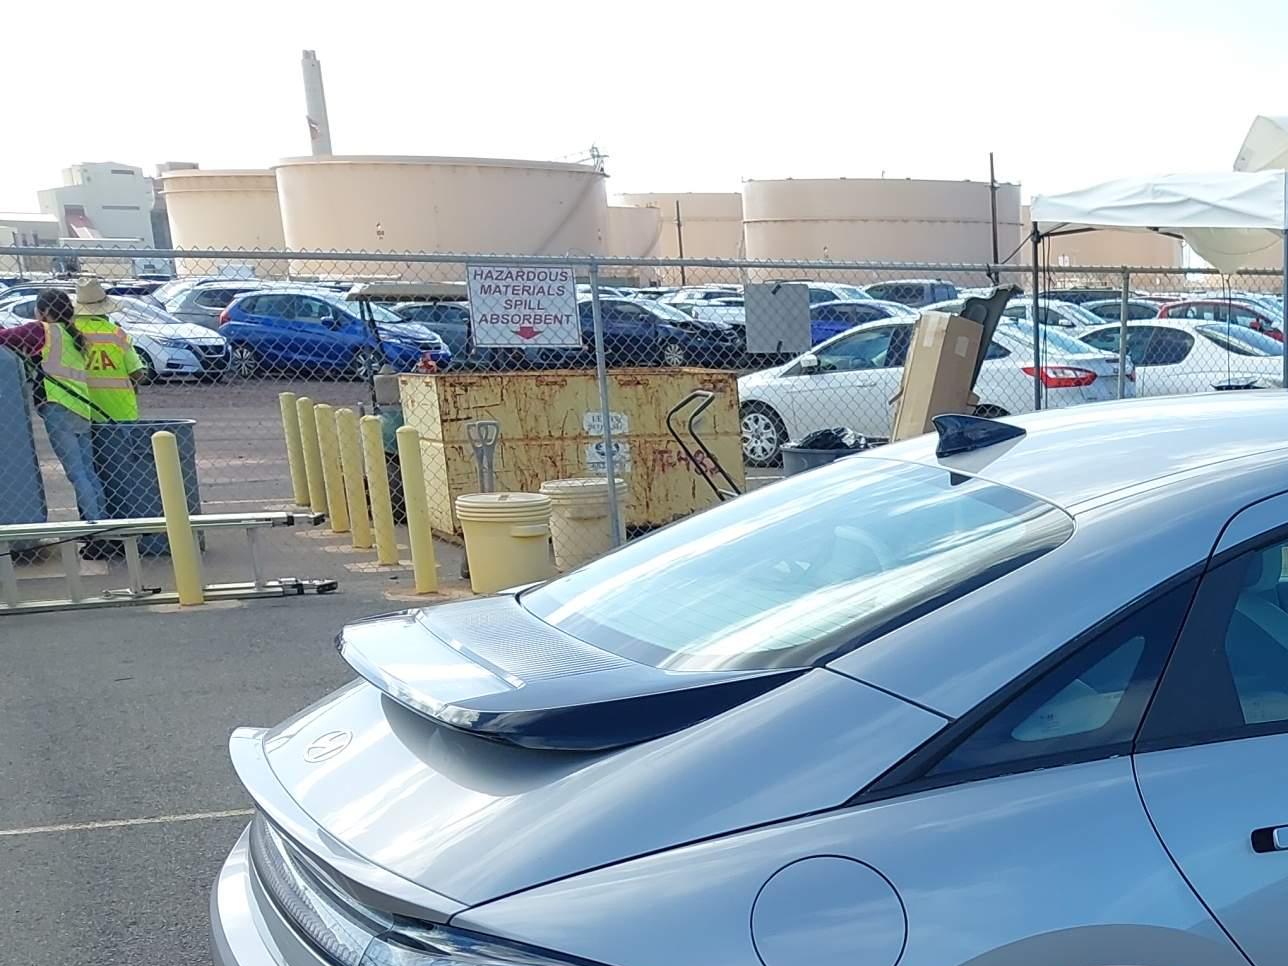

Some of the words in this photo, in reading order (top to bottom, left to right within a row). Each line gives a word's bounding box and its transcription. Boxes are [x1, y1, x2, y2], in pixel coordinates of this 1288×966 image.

[473, 270, 568, 282] HAZARDOUS
[480, 285, 565, 296] MATERIALS
[504, 299, 545, 311] SPILL
[478, 313, 573, 325] ABSORBENT
